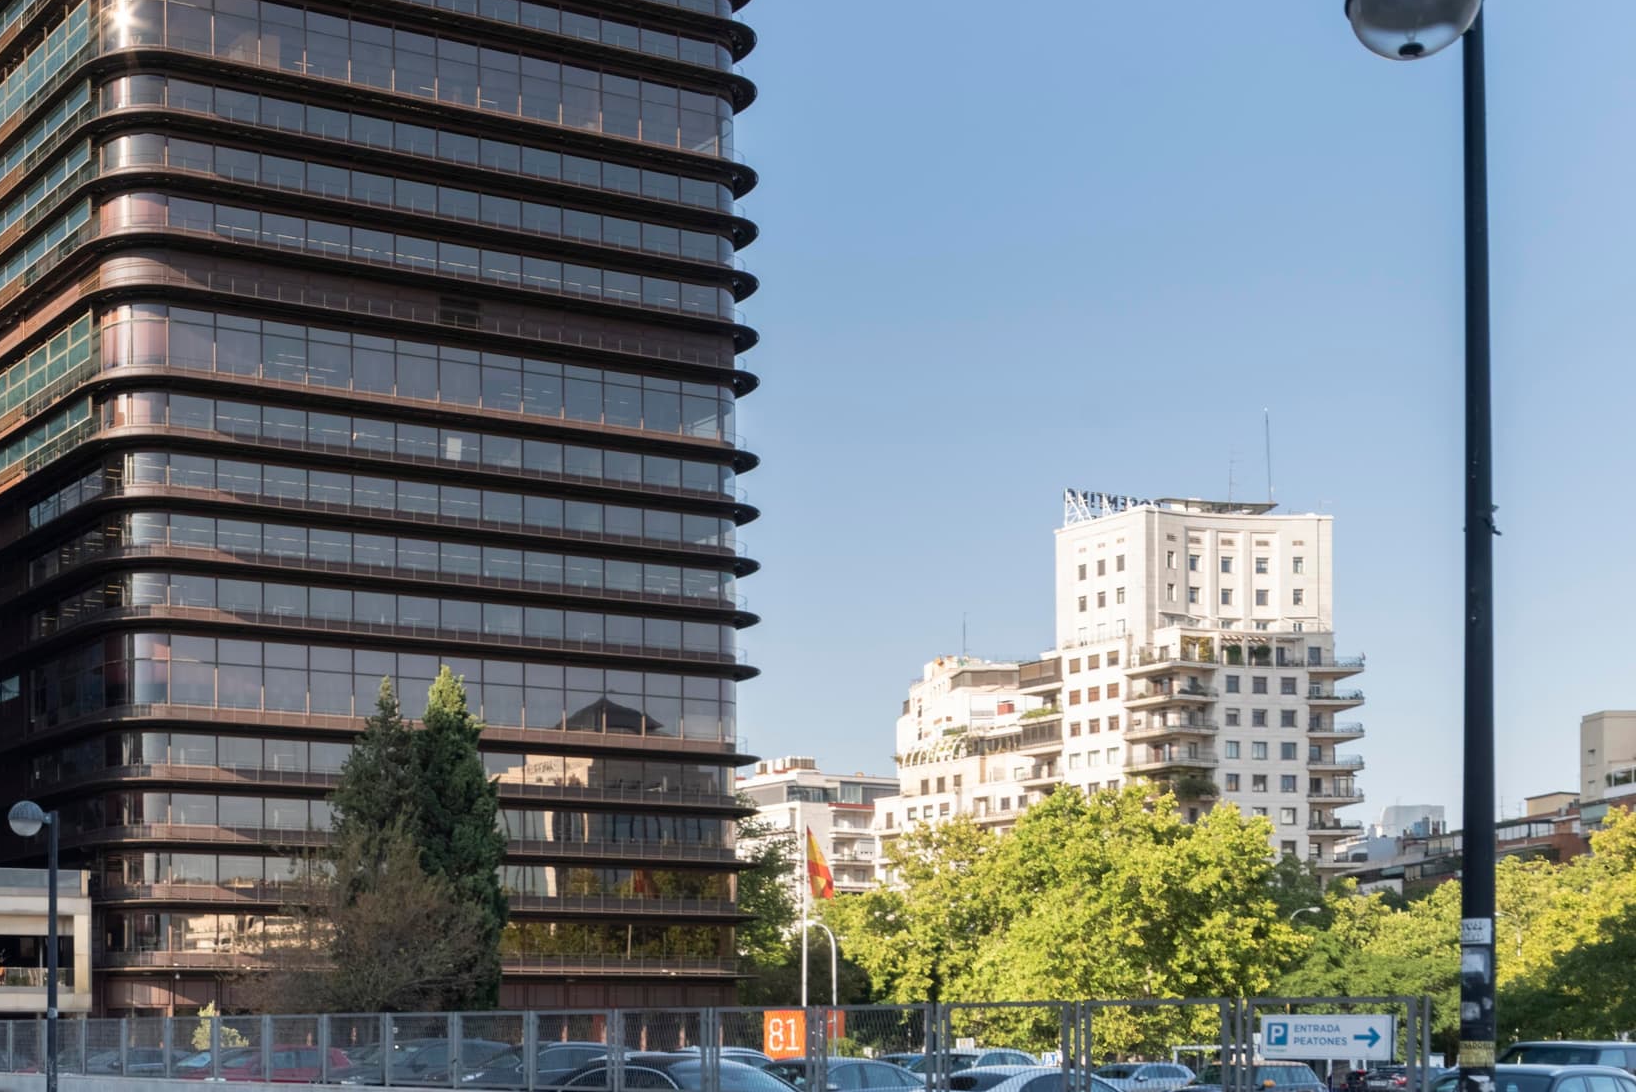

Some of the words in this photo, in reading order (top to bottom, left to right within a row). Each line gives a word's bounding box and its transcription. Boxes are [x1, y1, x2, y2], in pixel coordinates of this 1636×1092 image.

[769, 1018, 800, 1051] 81
[1270, 1025, 1284, 1044] P
[1294, 1024, 1340, 1033] ENTRADA
[1294, 1036, 1347, 1046] PEATONES
